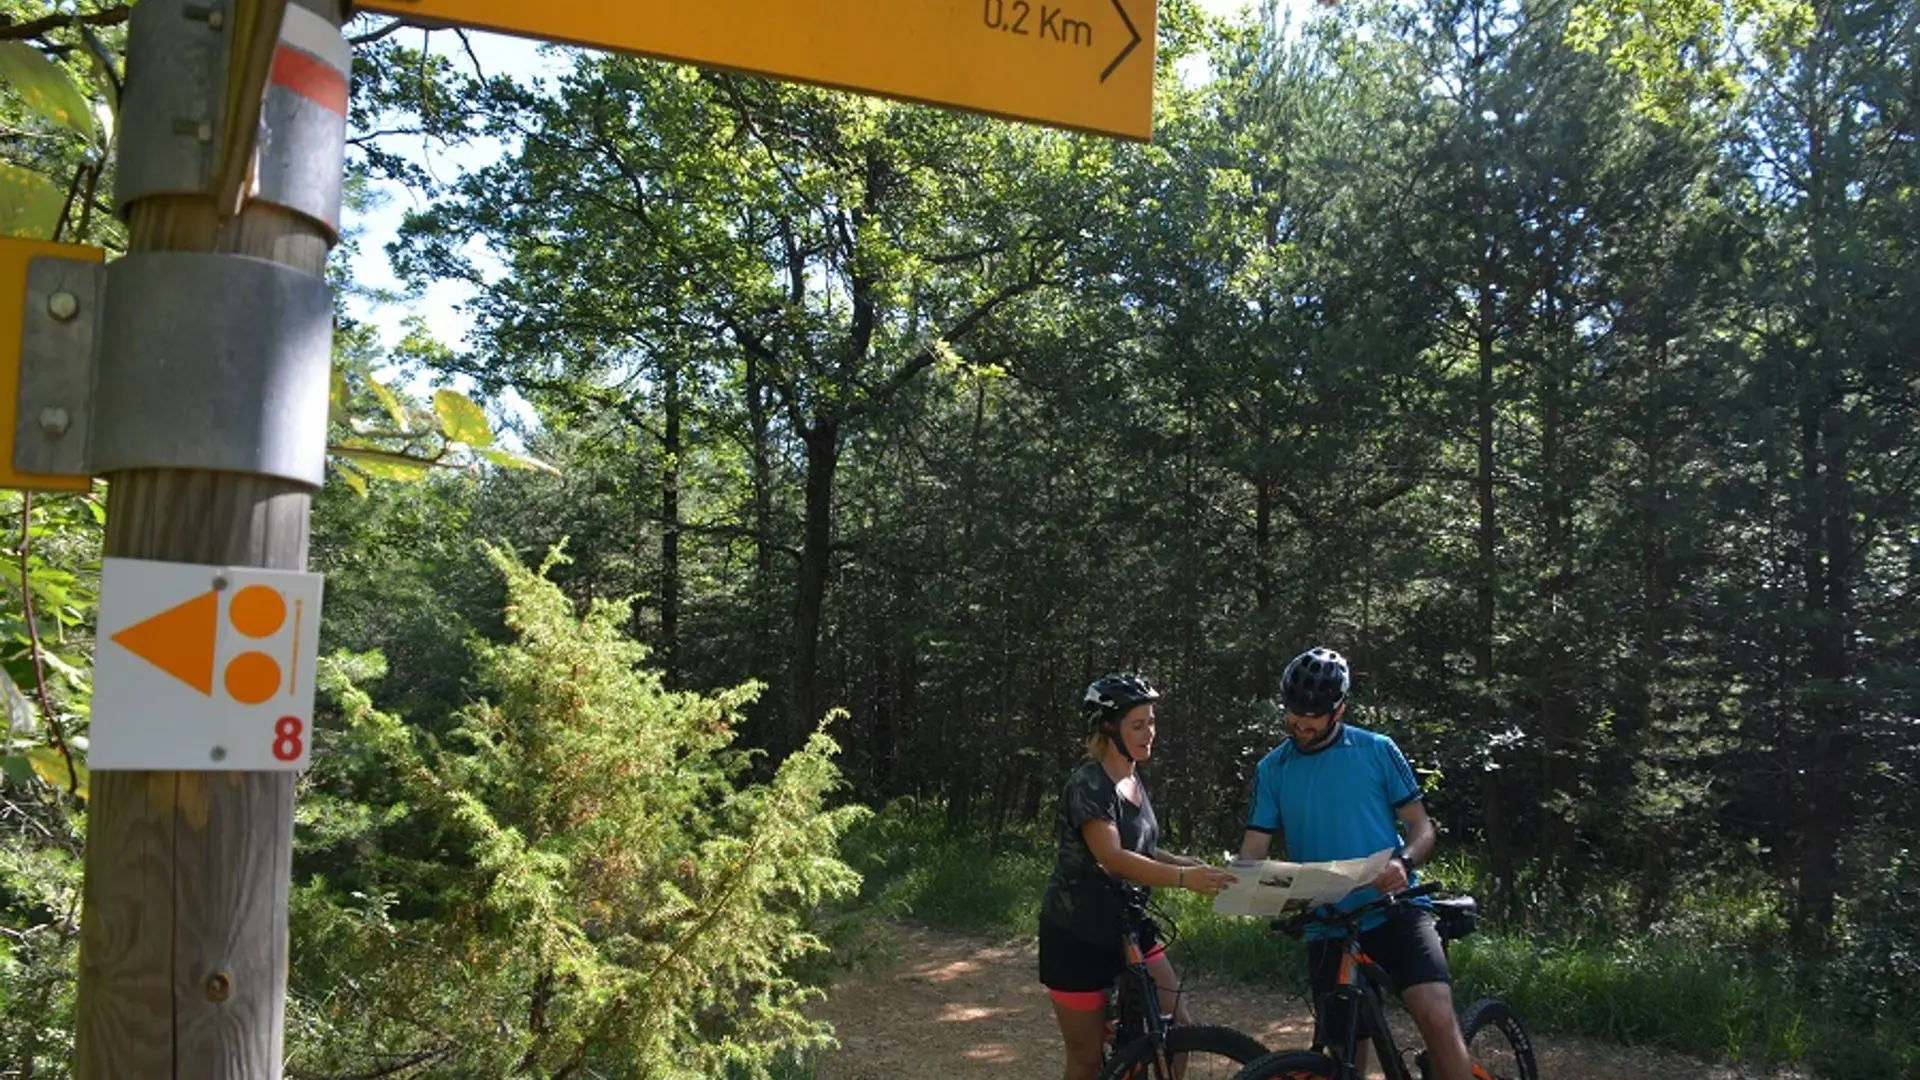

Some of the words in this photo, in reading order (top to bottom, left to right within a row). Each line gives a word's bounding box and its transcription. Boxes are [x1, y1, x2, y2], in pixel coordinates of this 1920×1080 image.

[983, 0, 1029, 36] 0.2
[1040, 5, 1092, 47] Km
[272, 715, 303, 762] 8
